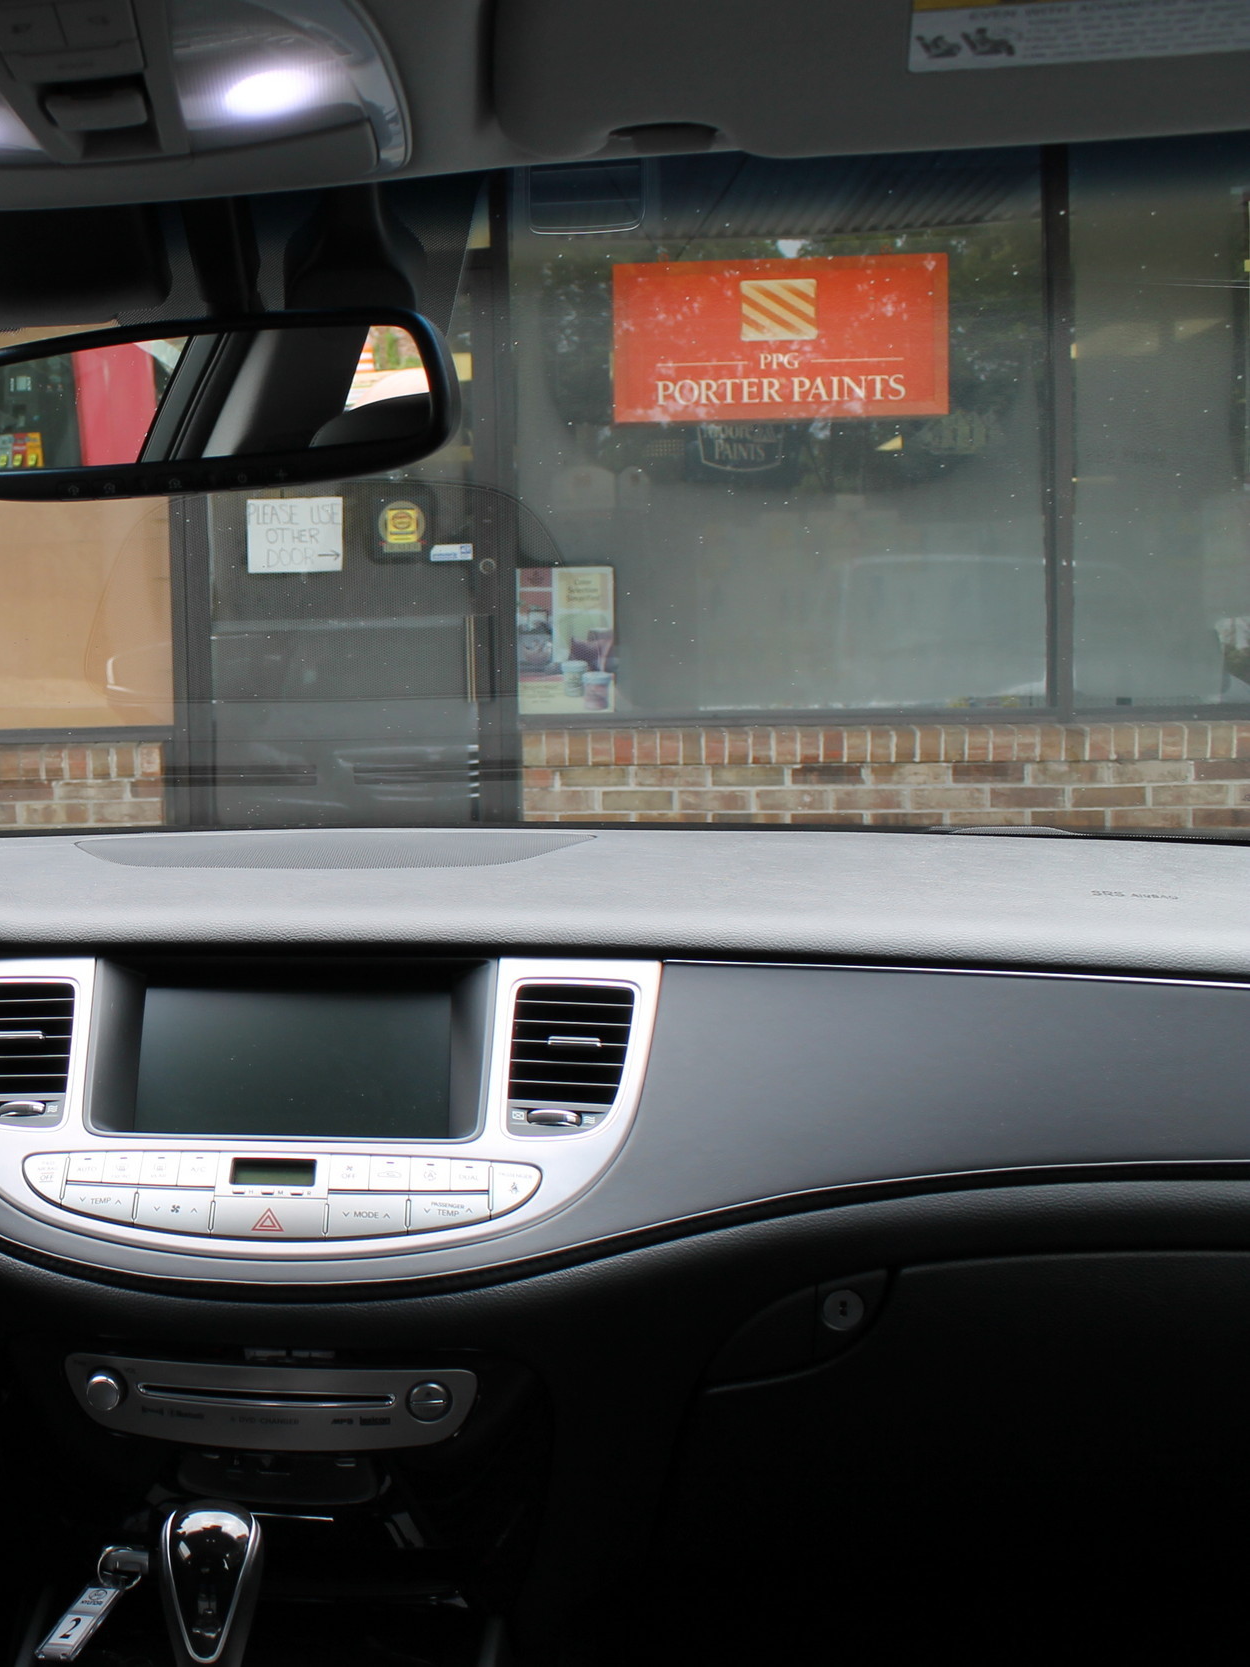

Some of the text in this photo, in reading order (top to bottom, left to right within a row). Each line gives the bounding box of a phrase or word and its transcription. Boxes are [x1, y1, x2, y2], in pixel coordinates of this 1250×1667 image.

[758, 351, 800, 370] PPG
[655, 372, 907, 406] PORTER PAINTS
[715, 440, 765, 461] PAINTS
[247, 502, 342, 526] PLEASE USE
[265, 527, 320, 545] OTHER
[266, 546, 314, 569] DOOR
[90, 1196, 112, 1206] TEMP
[430, 1200, 466, 1210] PASSENGER
[353, 1210, 380, 1219] MODE
[436, 1208, 461, 1218] TEMP
[58, 1616, 82, 1640] 2
